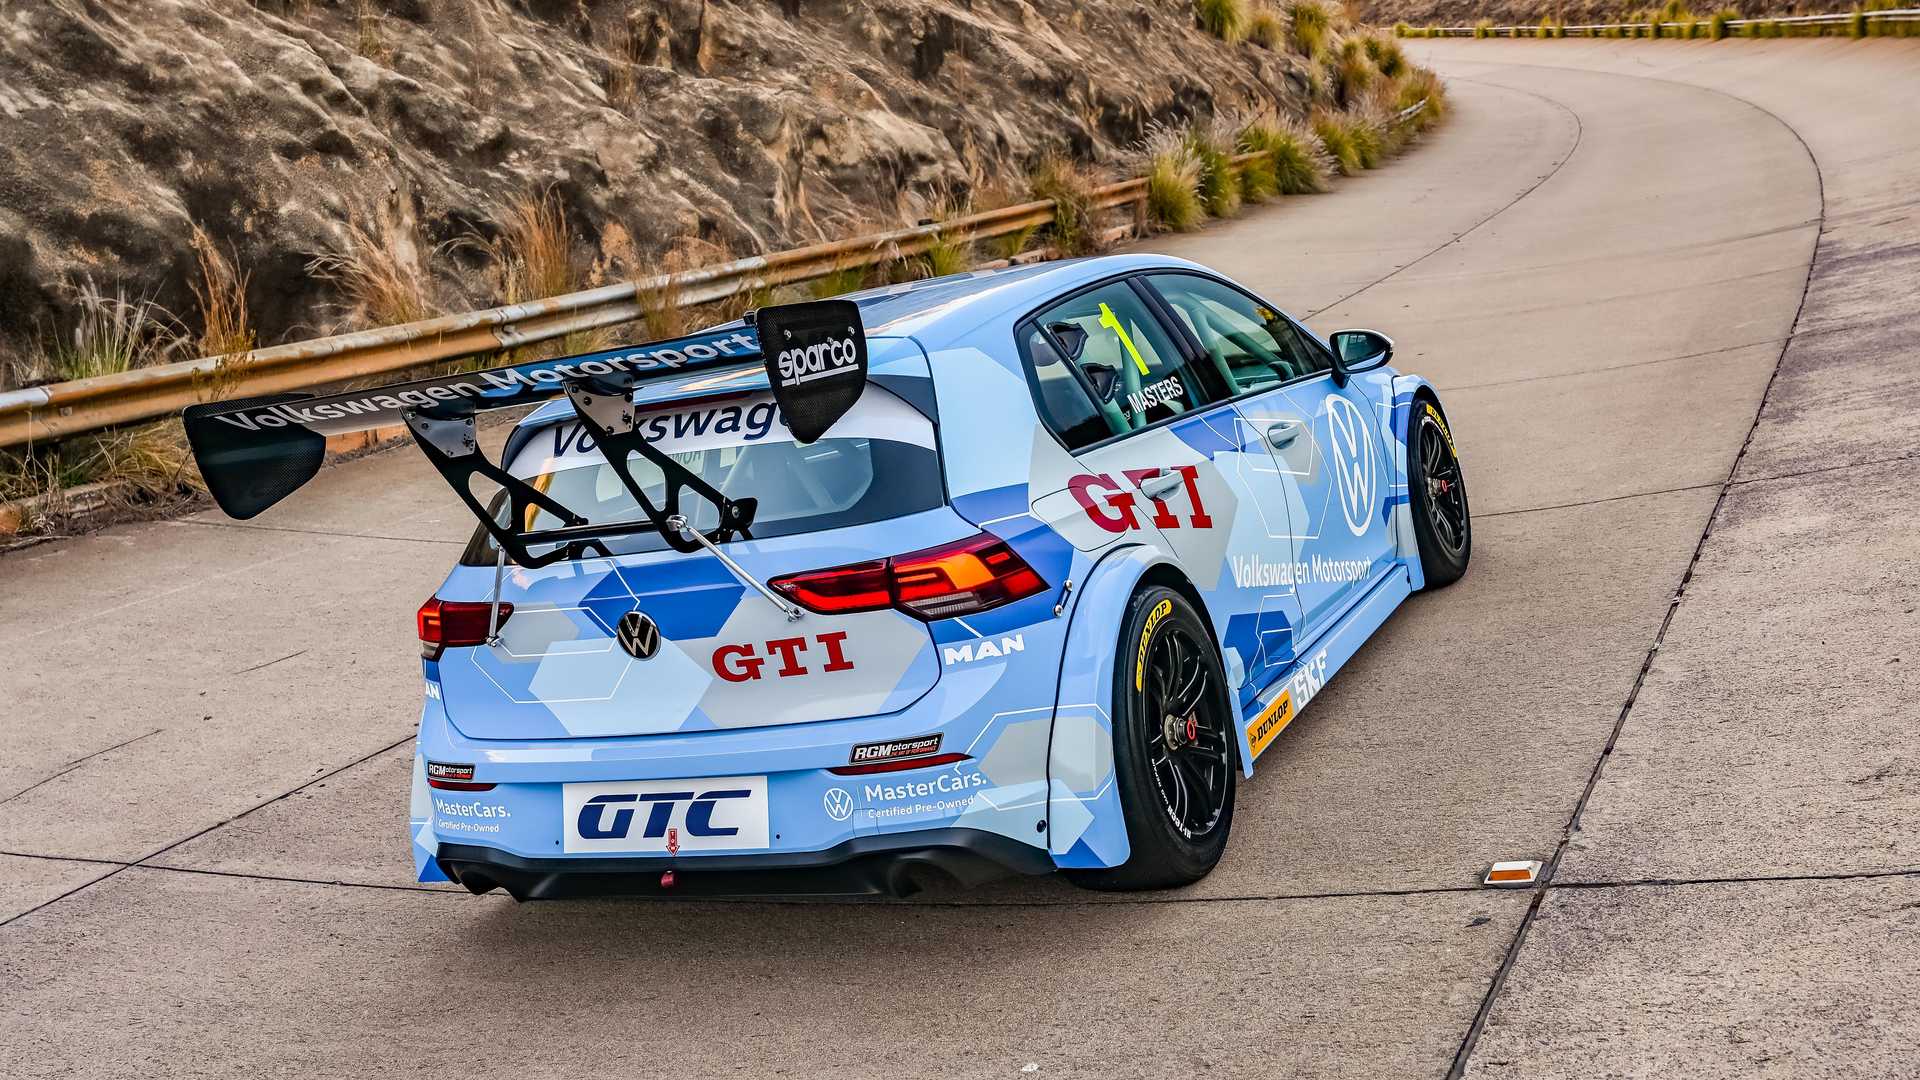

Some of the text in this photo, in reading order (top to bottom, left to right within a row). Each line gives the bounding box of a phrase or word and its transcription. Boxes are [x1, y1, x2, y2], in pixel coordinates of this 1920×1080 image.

[1098, 302, 1150, 376] 1
[214, 333, 761, 431] Volkswagen Motorsport
[778, 338, 858, 386] sparco
[1127, 376, 1183, 413] MASTERS
[553, 402, 788, 458] Voswag
[1067, 465, 1213, 533] GTI
[1233, 553, 1372, 593] Volkswagen Motorsport
[712, 630, 855, 683] GTI
[944, 634, 1025, 666] MAN
[1294, 648, 1328, 707] SKF
[1257, 700, 1289, 741] DUNLOP
[855, 737, 939, 760] RGMotorsport
[865, 772, 987, 802] MasterCars.
[436, 799, 511, 818] MasterCars.
[438, 819, 500, 833] Certified Pre-Owned
[577, 789, 752, 839] GTC
[868, 797, 975, 819] Certified Pre-Owned
